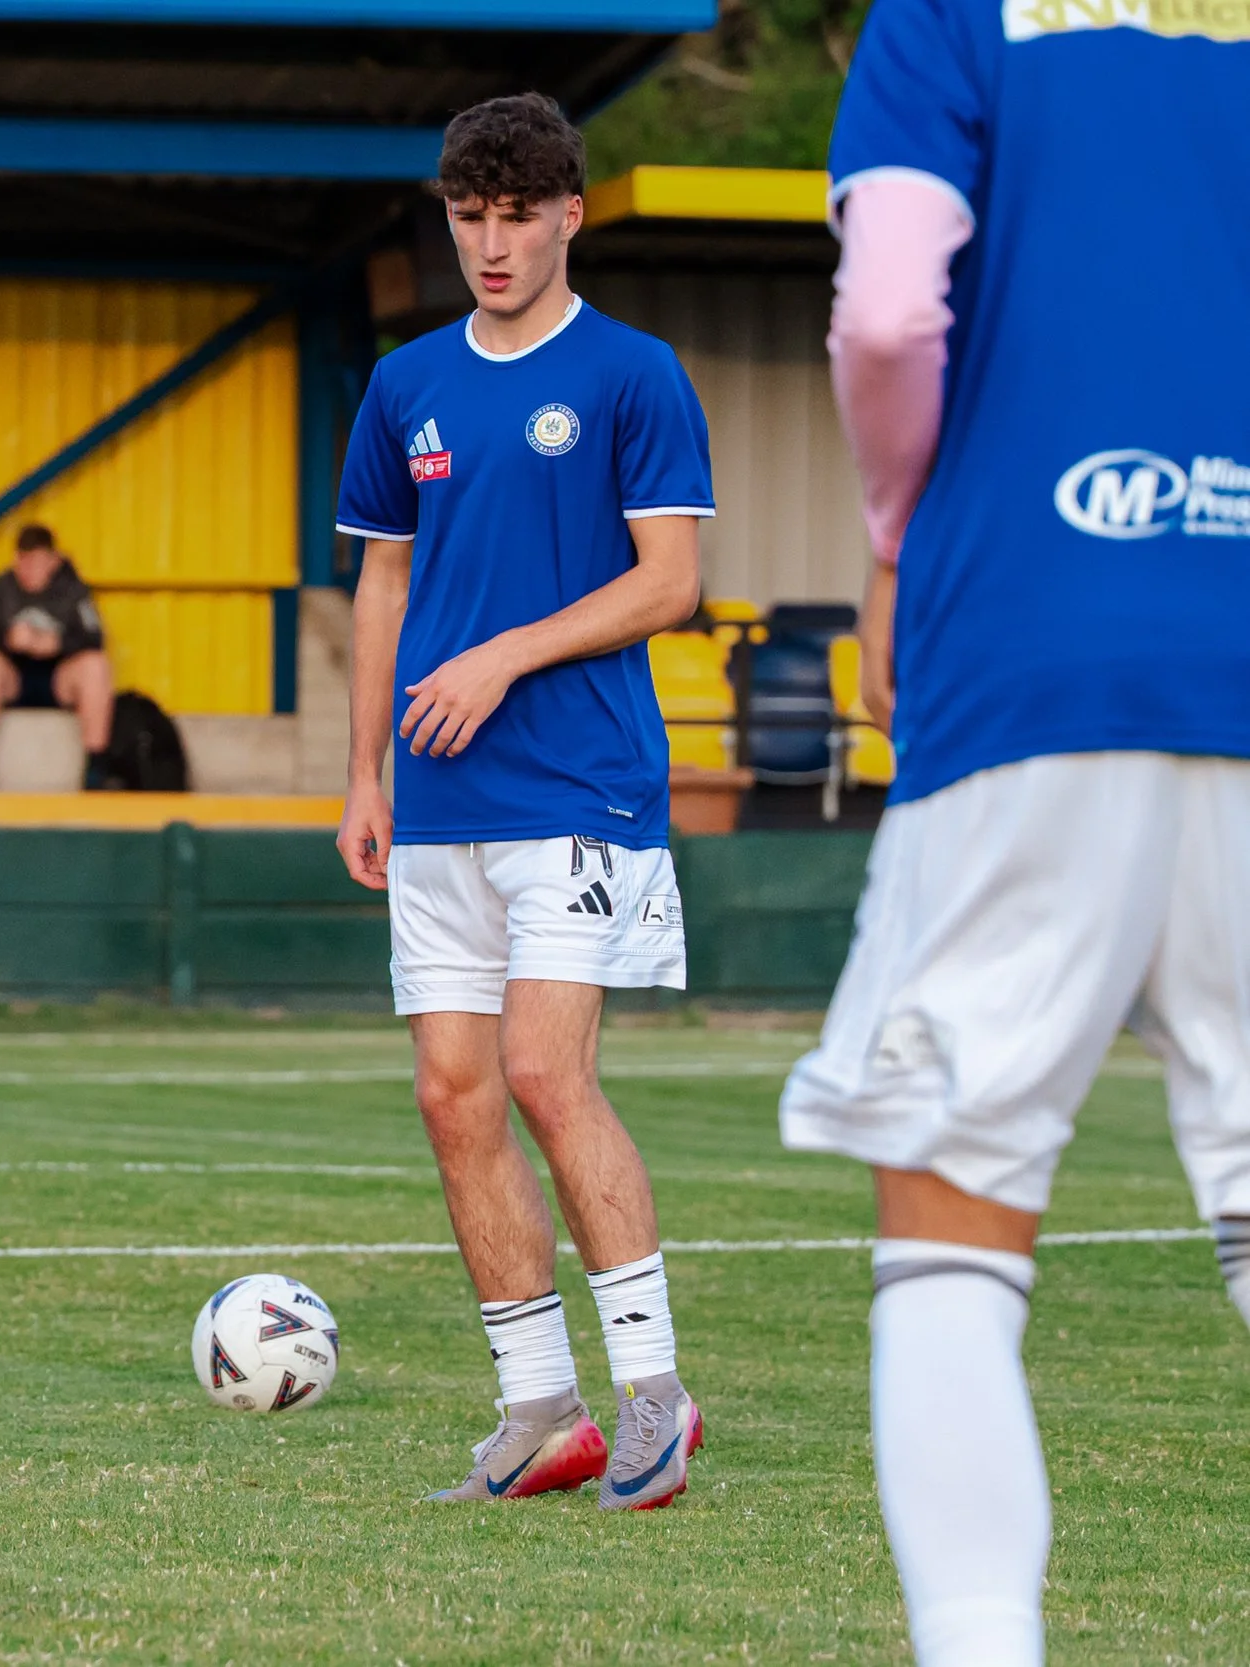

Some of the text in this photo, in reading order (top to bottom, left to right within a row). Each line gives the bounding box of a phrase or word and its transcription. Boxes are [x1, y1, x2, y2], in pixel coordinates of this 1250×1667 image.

[531, 405, 577, 428] CURZON ASHTON
[529, 432, 574, 453] FOOTBALL CLUB
